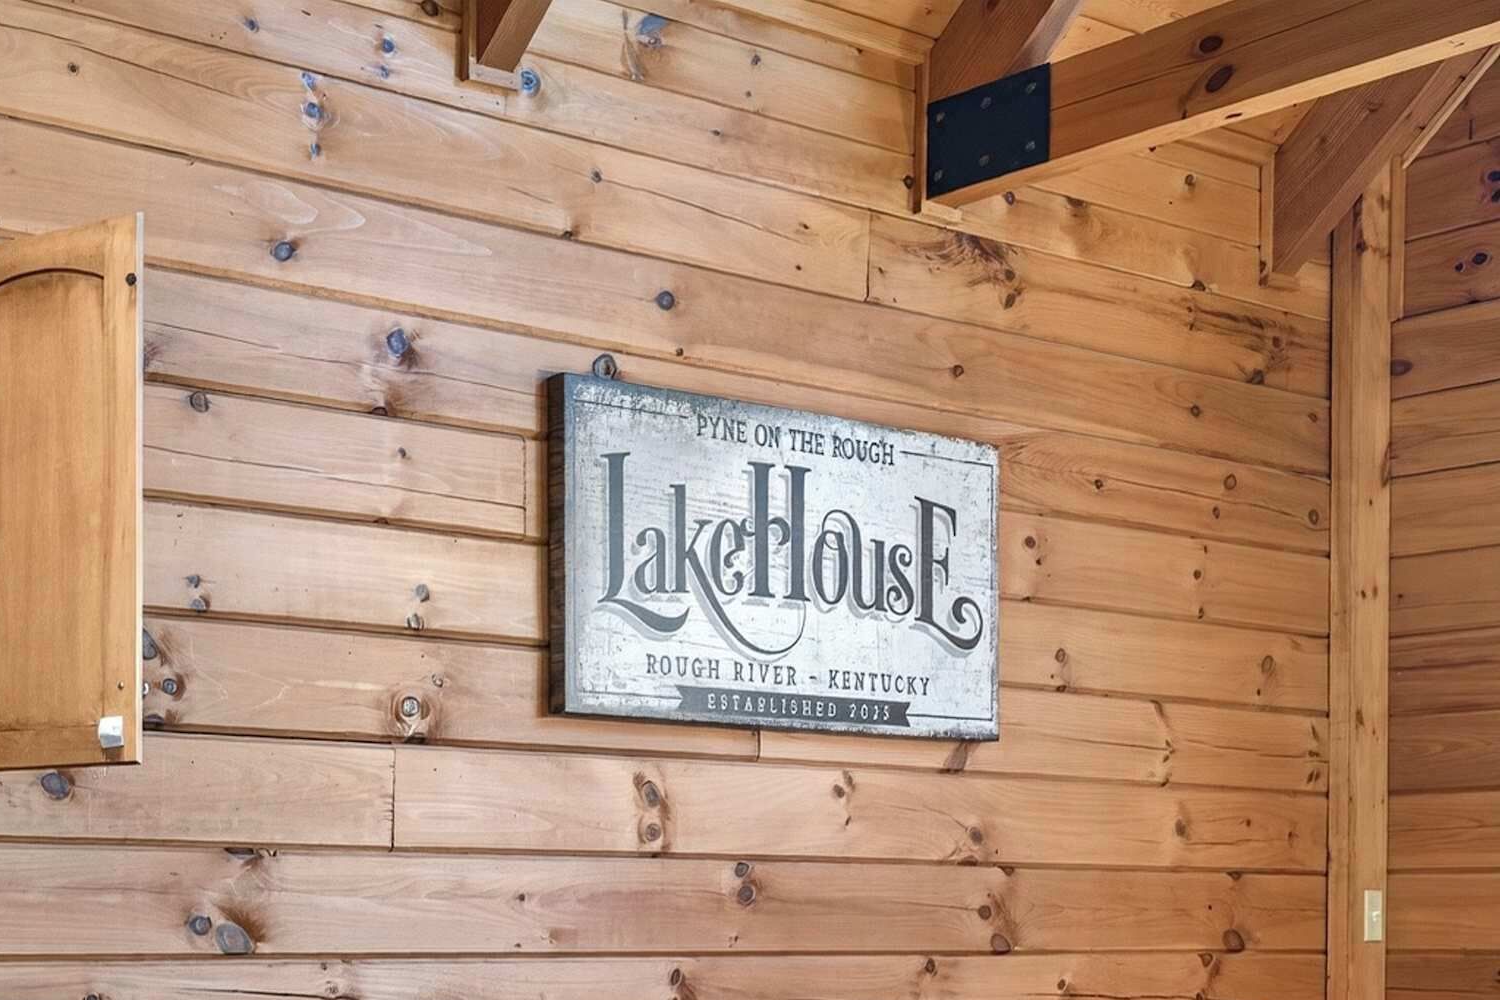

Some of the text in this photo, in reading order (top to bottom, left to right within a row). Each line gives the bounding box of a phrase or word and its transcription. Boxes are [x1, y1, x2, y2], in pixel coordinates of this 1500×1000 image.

[696, 413, 896, 466] PYNE ON THE ROUGH
[645, 653, 721, 680] ROUGH
[734, 661, 797, 686] RIVER
[828, 669, 931, 696] KENTUCKY
[707, 693, 838, 718] ESTABLISHED
